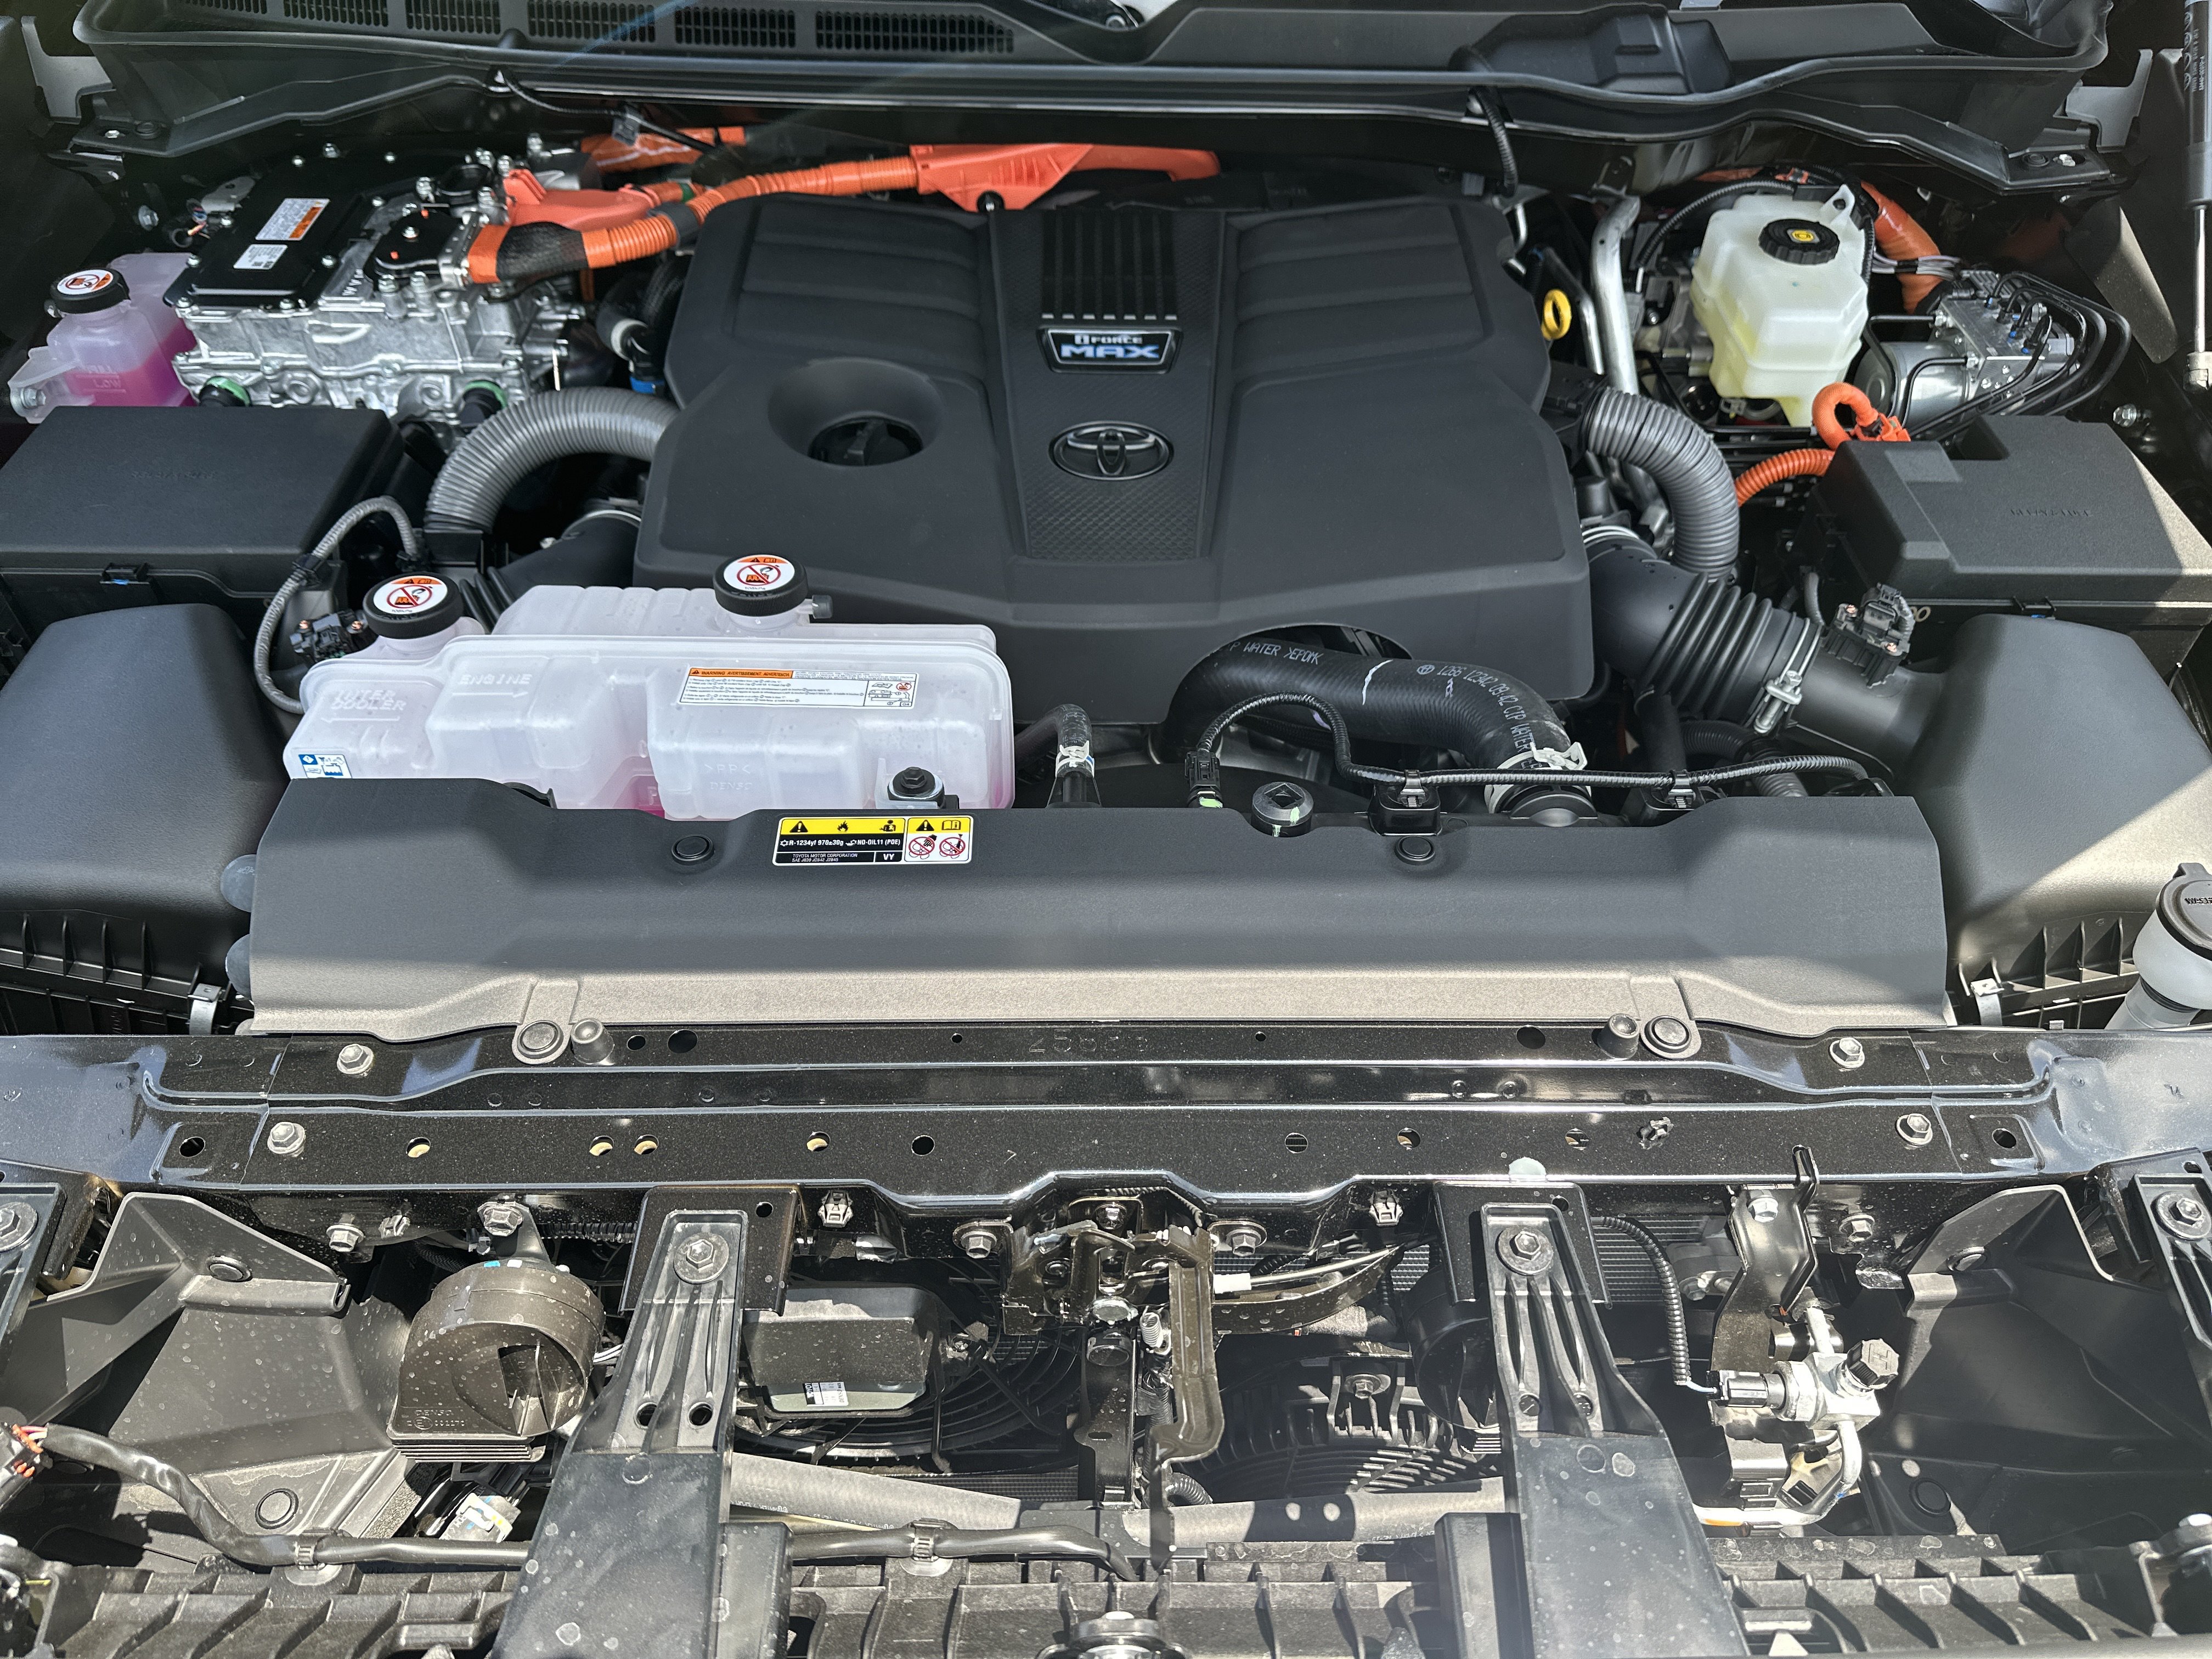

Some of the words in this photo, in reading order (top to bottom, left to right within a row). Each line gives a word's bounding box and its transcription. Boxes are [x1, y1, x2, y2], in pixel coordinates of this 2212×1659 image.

[1059, 344, 1160, 358] MAX
[1243, 641, 1282, 657] WATER
[459, 674, 532, 685] ENGINE
[1436, 664, 1468, 678] 1266
[1462, 669, 1499, 688] 12342
[334, 690, 397, 701] INTER
[331, 699, 407, 711] COOLER
[709, 781, 753, 791] DENSO
[884, 838, 901, 847] (POE)
[1868, 1343, 1892, 1373] H
